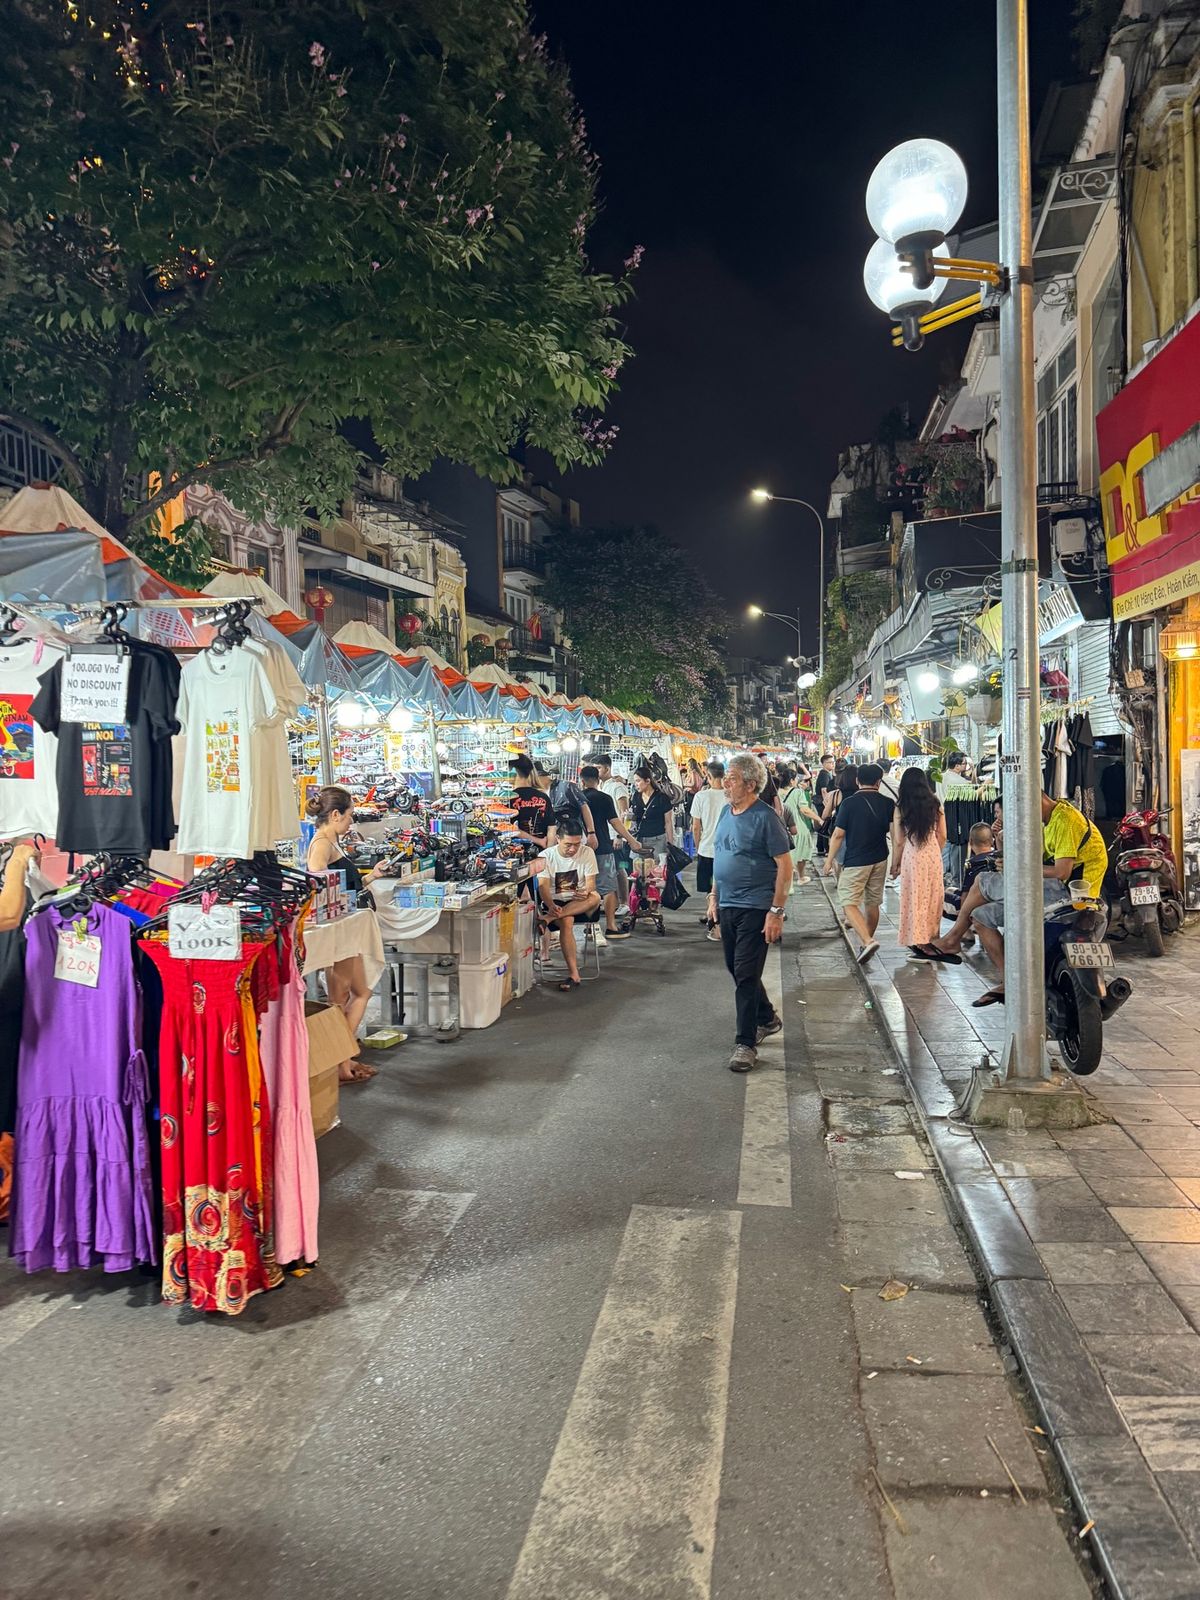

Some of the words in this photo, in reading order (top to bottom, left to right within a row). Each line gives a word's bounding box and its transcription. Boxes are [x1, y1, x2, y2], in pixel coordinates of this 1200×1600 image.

[72, 663, 102, 673] 100.000
[67, 679, 78, 689] NO
[81, 680, 122, 691] DISCOUNT
[70, 696, 93, 706] Thank
[174, 936, 234, 950] 100K
[58, 955, 97, 975] 120K
[1070, 955, 1110, 966] 766.17
